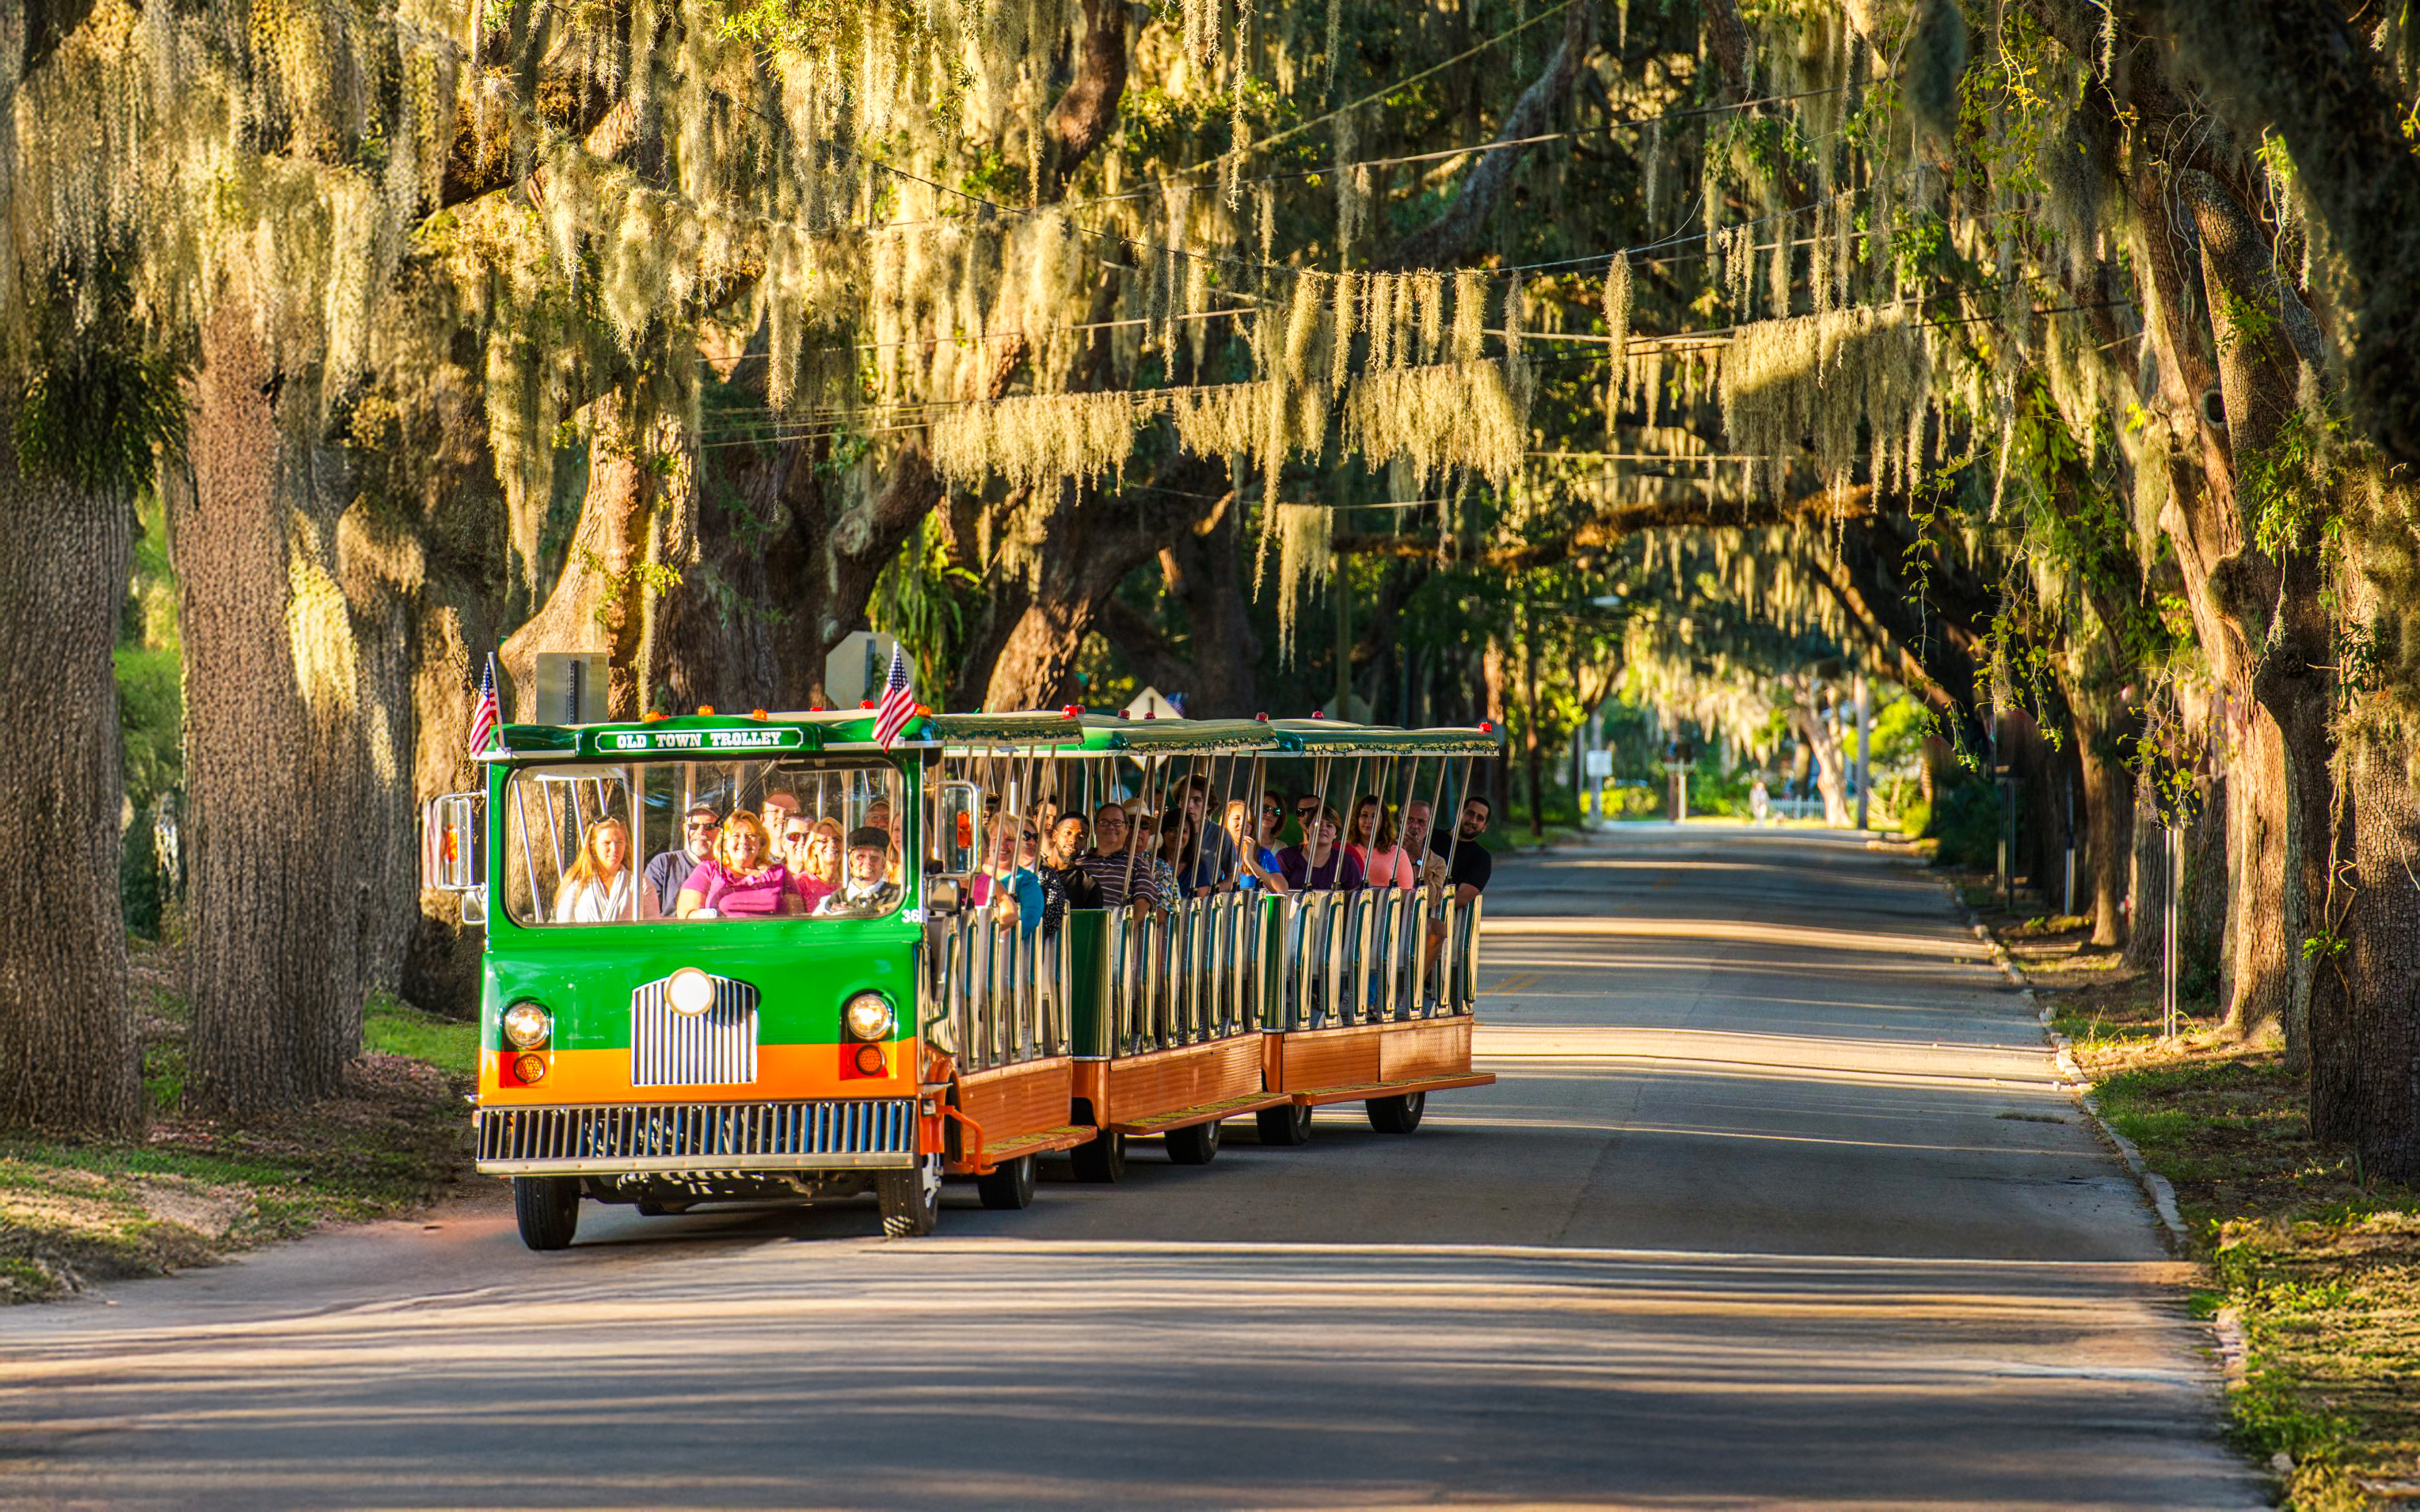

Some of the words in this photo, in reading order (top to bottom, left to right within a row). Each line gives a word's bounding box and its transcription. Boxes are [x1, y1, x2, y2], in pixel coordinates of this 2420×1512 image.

[616, 735, 646, 748] OLD
[656, 733, 702, 747] TOWN
[710, 731, 781, 747] TROLLEY
